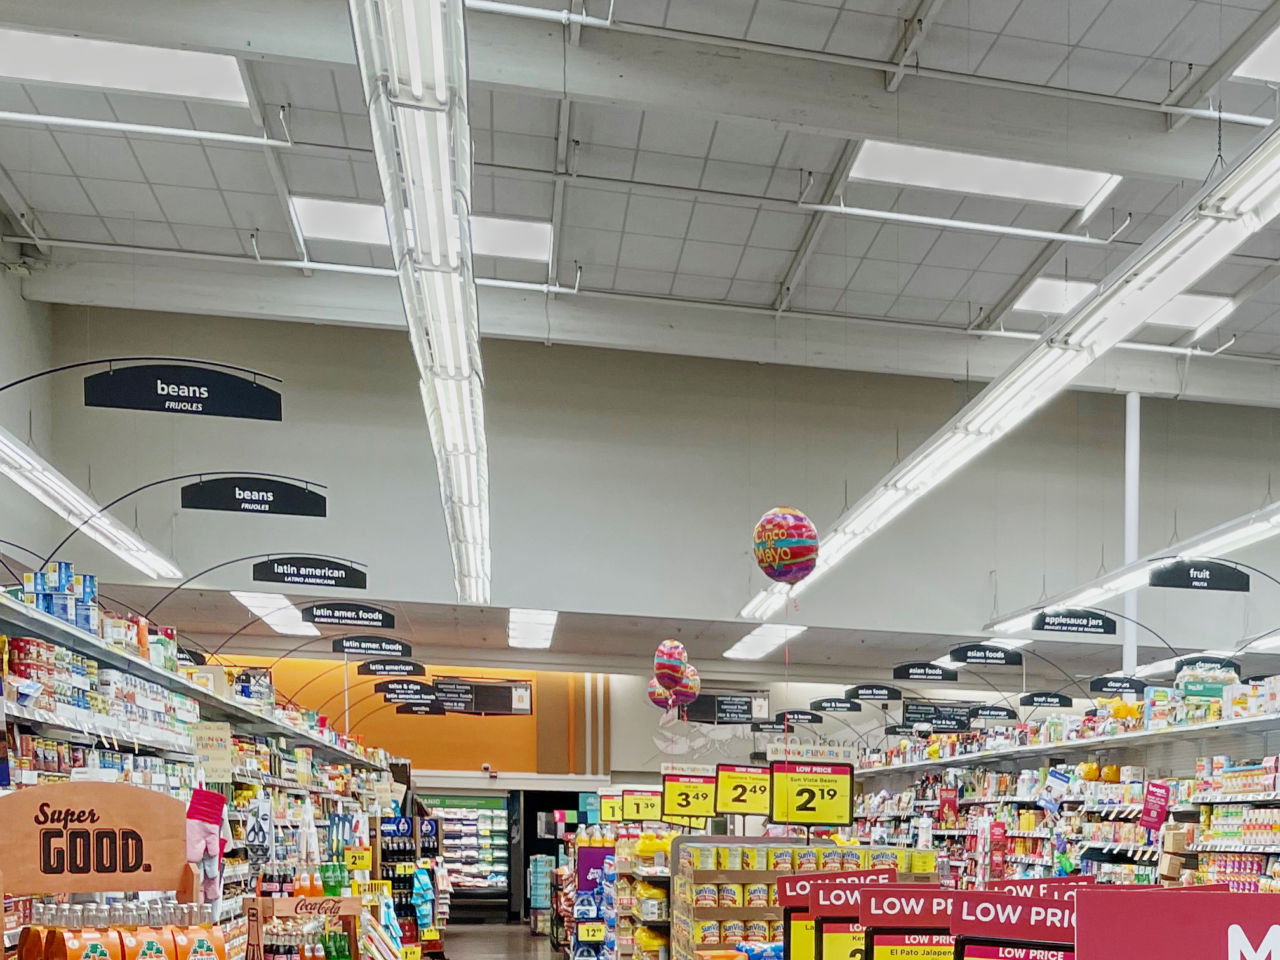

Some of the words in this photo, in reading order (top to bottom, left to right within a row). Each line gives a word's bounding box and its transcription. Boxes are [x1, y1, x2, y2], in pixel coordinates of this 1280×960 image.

[157, 380, 208, 397] beans
[165, 401, 202, 411] FRIJOLES
[235, 488, 273, 500] beans
[755, 528, 786, 543] Cinco
[754, 546, 791, 569] Mayo
[274, 564, 297, 574] latin
[300, 566, 345, 578] american
[1190, 569, 1210, 579] fruit
[314, 607, 332, 615] latin
[334, 609, 357, 618] amer.
[359, 611, 382, 620] foods
[1045, 616, 1087, 625] applesauce
[1089, 617, 1103, 626] jars
[34, 802, 100, 829] Super
[295, 899, 342, 915] Coca-Cola
[871, 897, 924, 914] LOW
[962, 901, 1022, 924] LOW
[1030, 907, 1076, 928] PRI
[905, 935, 928, 944] LOW
[933, 935, 955, 944] PRIC
[999, 948, 1026, 958] LOW
[1029, 949, 1064, 960] PRICE
